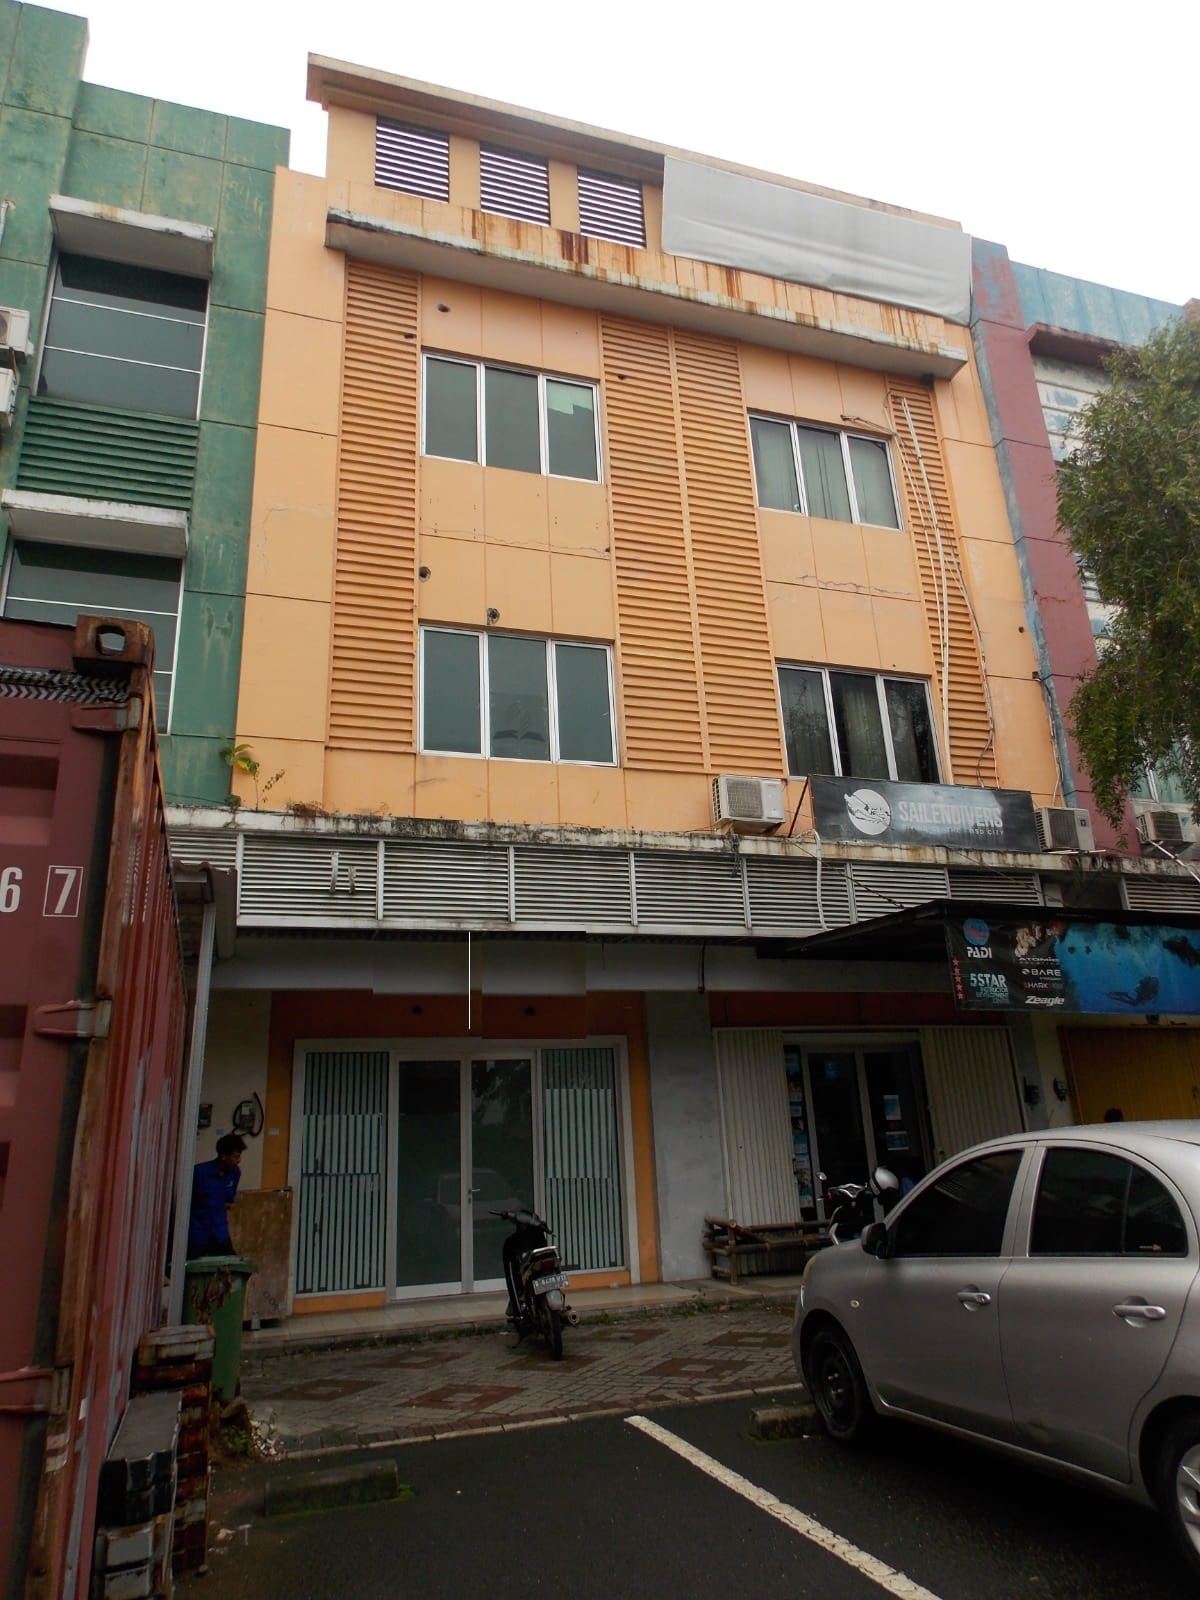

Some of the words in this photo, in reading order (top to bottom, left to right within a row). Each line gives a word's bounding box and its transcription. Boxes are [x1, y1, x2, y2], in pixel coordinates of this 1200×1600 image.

[0, 867, 22, 912] 6
[54, 869, 77, 913] 7
[966, 947, 993, 959] PADI
[1031, 968, 1062, 977] BARE
[1024, 995, 1065, 1007] Zeagle
